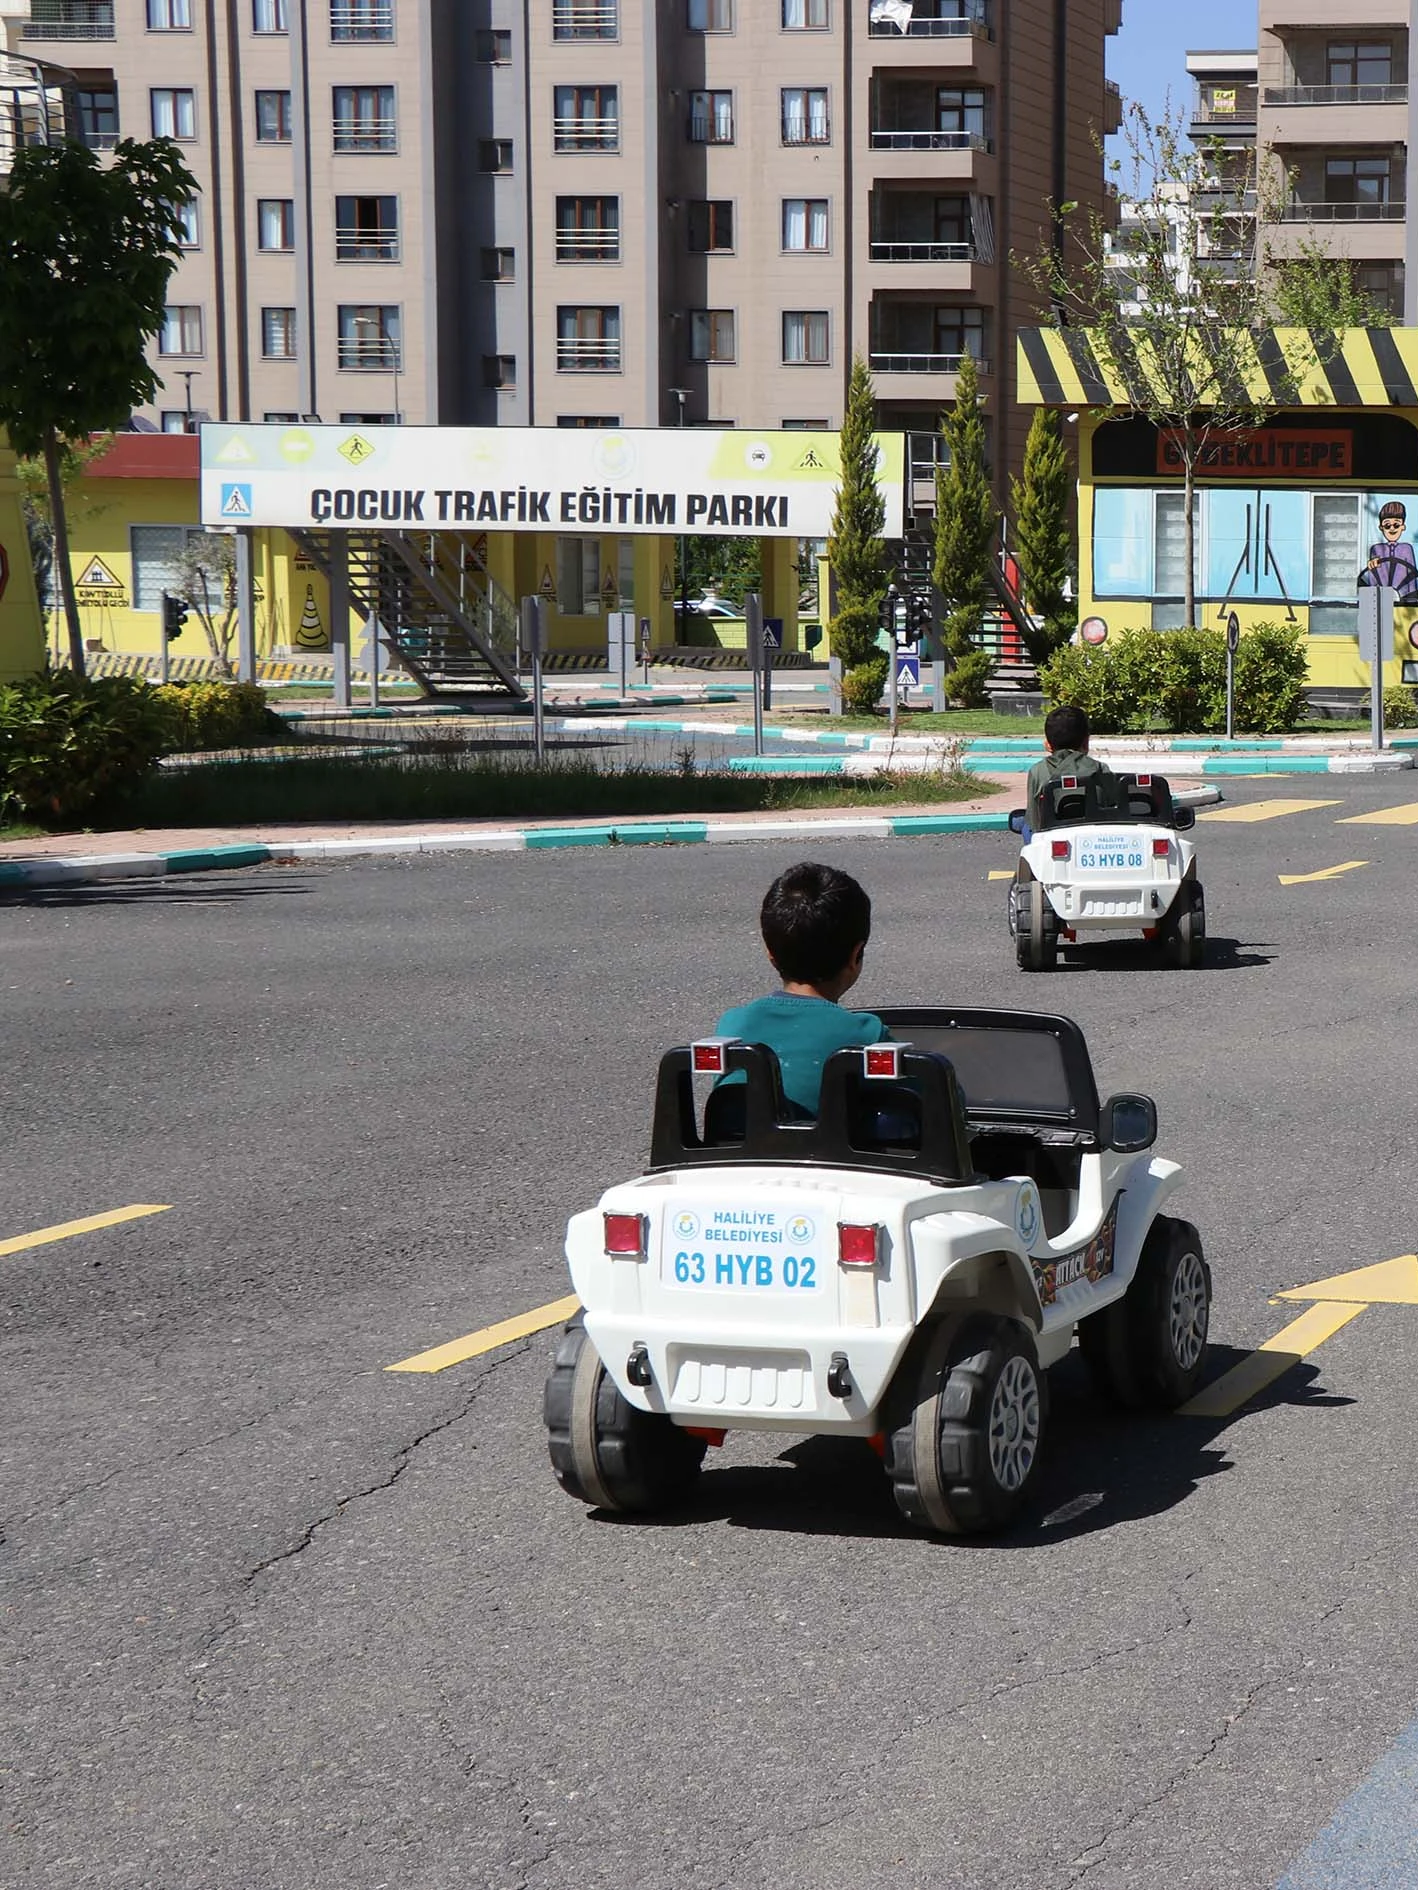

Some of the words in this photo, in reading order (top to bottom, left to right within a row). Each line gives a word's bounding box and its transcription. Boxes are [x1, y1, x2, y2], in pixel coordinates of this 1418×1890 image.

[1163, 433, 1345, 468] GBEKLİTEPE
[311, 489, 425, 523] ÇOCUK
[434, 486, 551, 522] TRAFİK
[560, 486, 676, 525] EĞİTİM
[686, 495, 788, 528] PARKI
[1081, 854, 1095, 867] 63
[1099, 854, 1124, 867] HYB
[1128, 853, 1142, 866] 08
[714, 1210, 775, 1225] HALİLİYE
[705, 1229, 782, 1243] BELEDİYESİ
[675, 1251, 705, 1283] 63
[715, 1254, 773, 1286] HYB
[783, 1256, 816, 1288] 02
[1056, 1252, 1085, 1287] ATTACK
